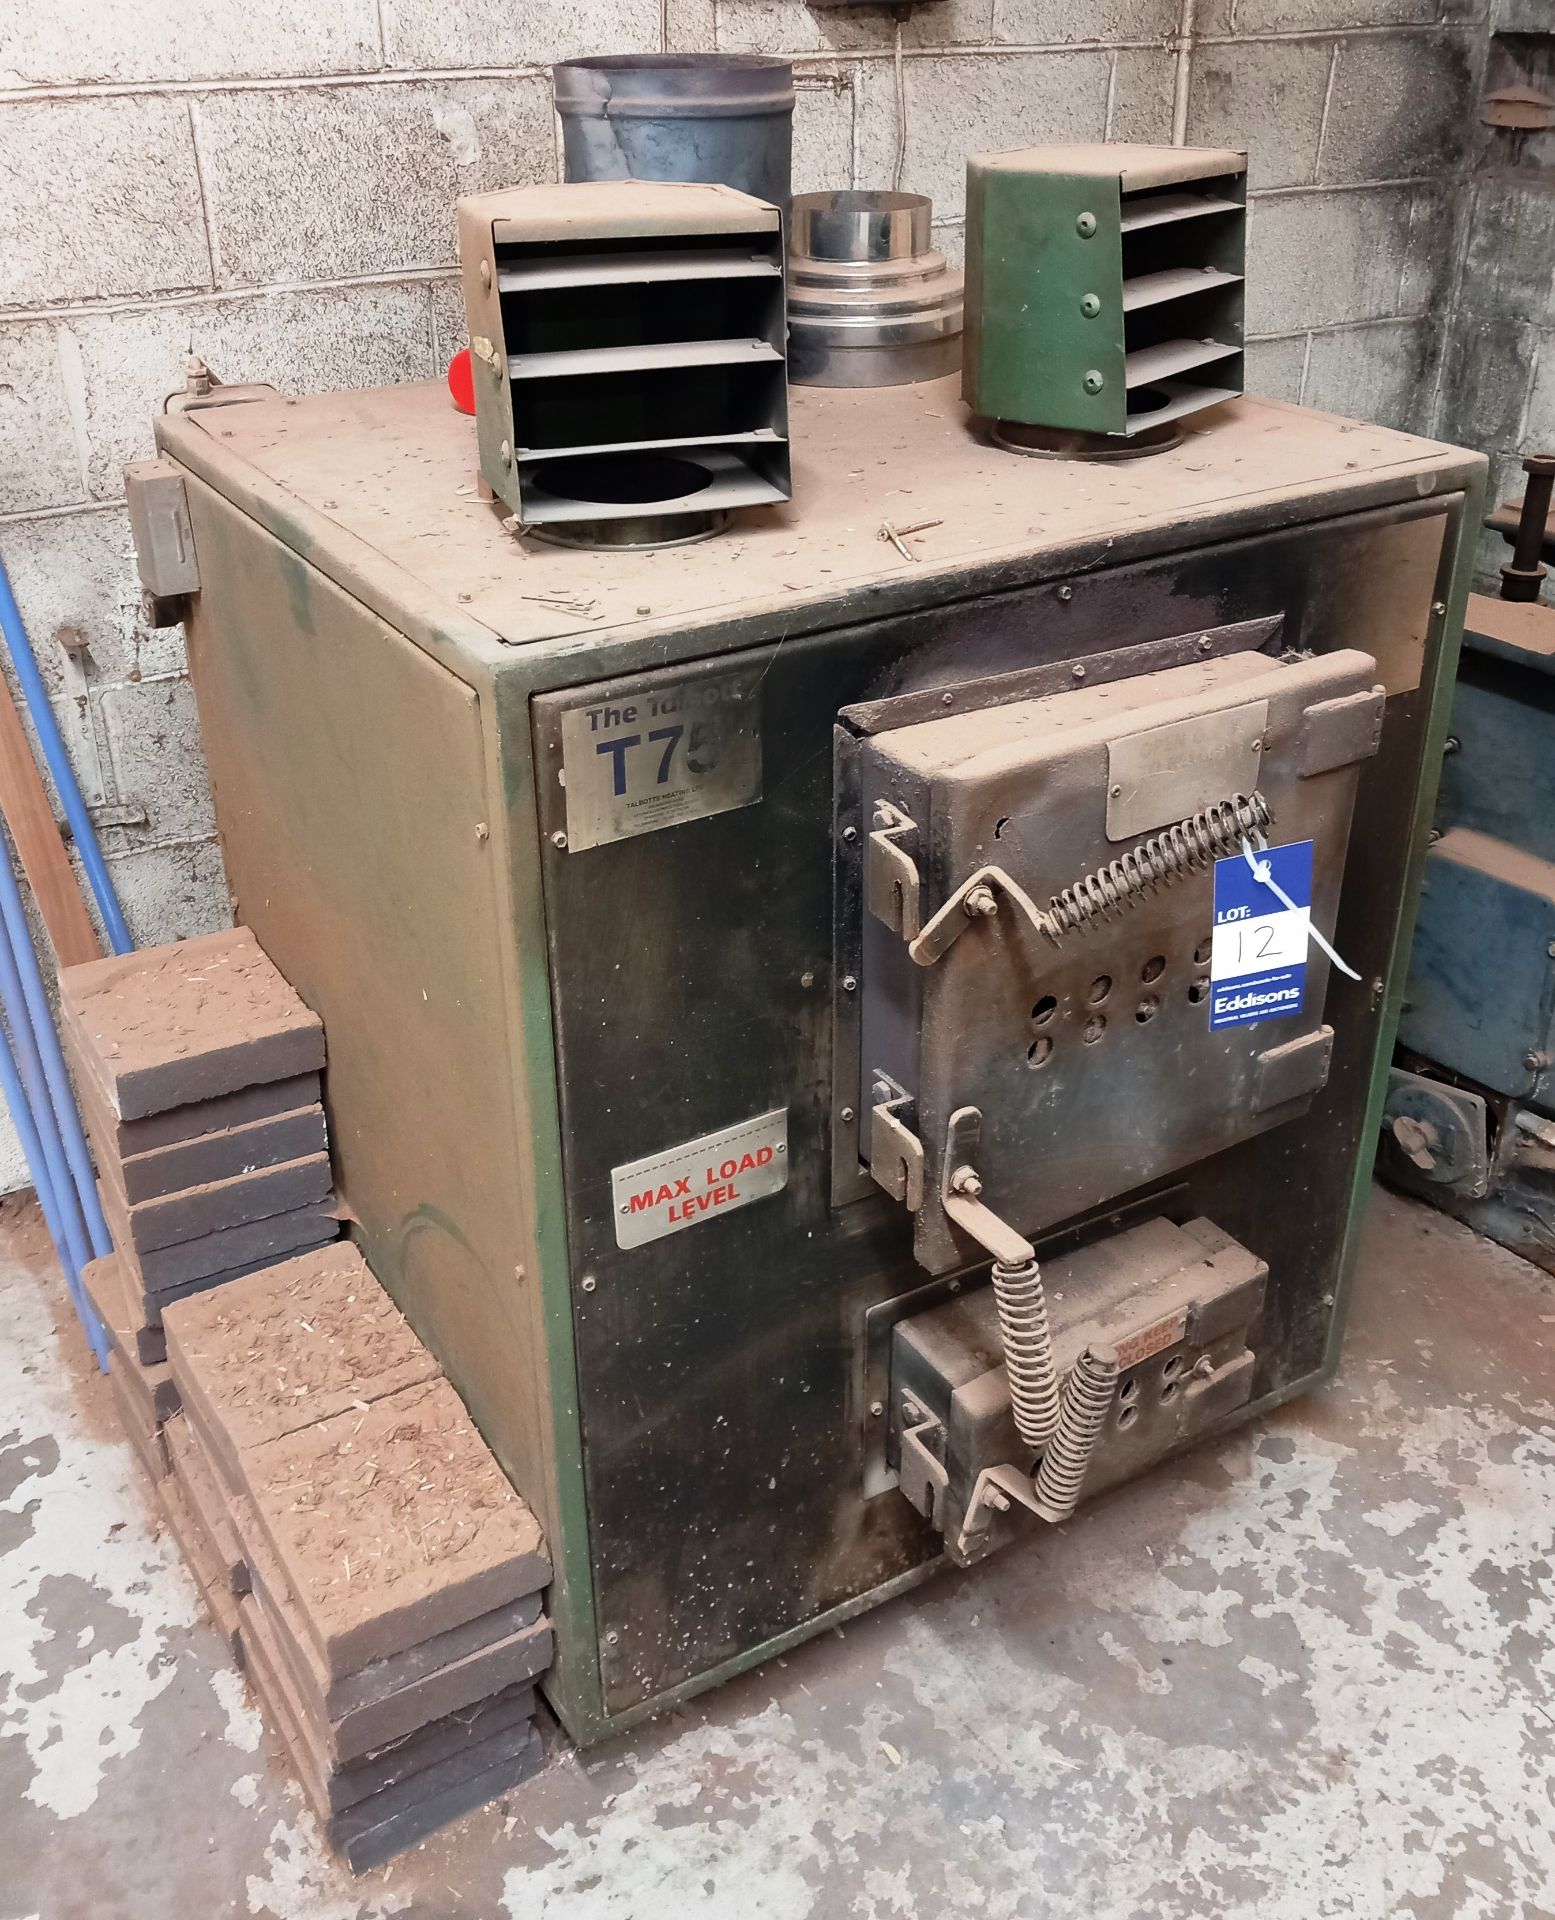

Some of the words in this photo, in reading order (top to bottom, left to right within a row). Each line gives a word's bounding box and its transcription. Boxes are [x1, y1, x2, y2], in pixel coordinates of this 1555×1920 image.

[586, 705, 638, 731] The
[596, 725, 720, 796] T75
[1217, 905, 1251, 924] LOT:
[1238, 925, 1283, 963] 12
[1214, 987, 1300, 1014] Eddisons
[630, 1176, 691, 1213] MAX
[706, 1146, 773, 1185] LOAD
[668, 1183, 740, 1223] LEVEL
